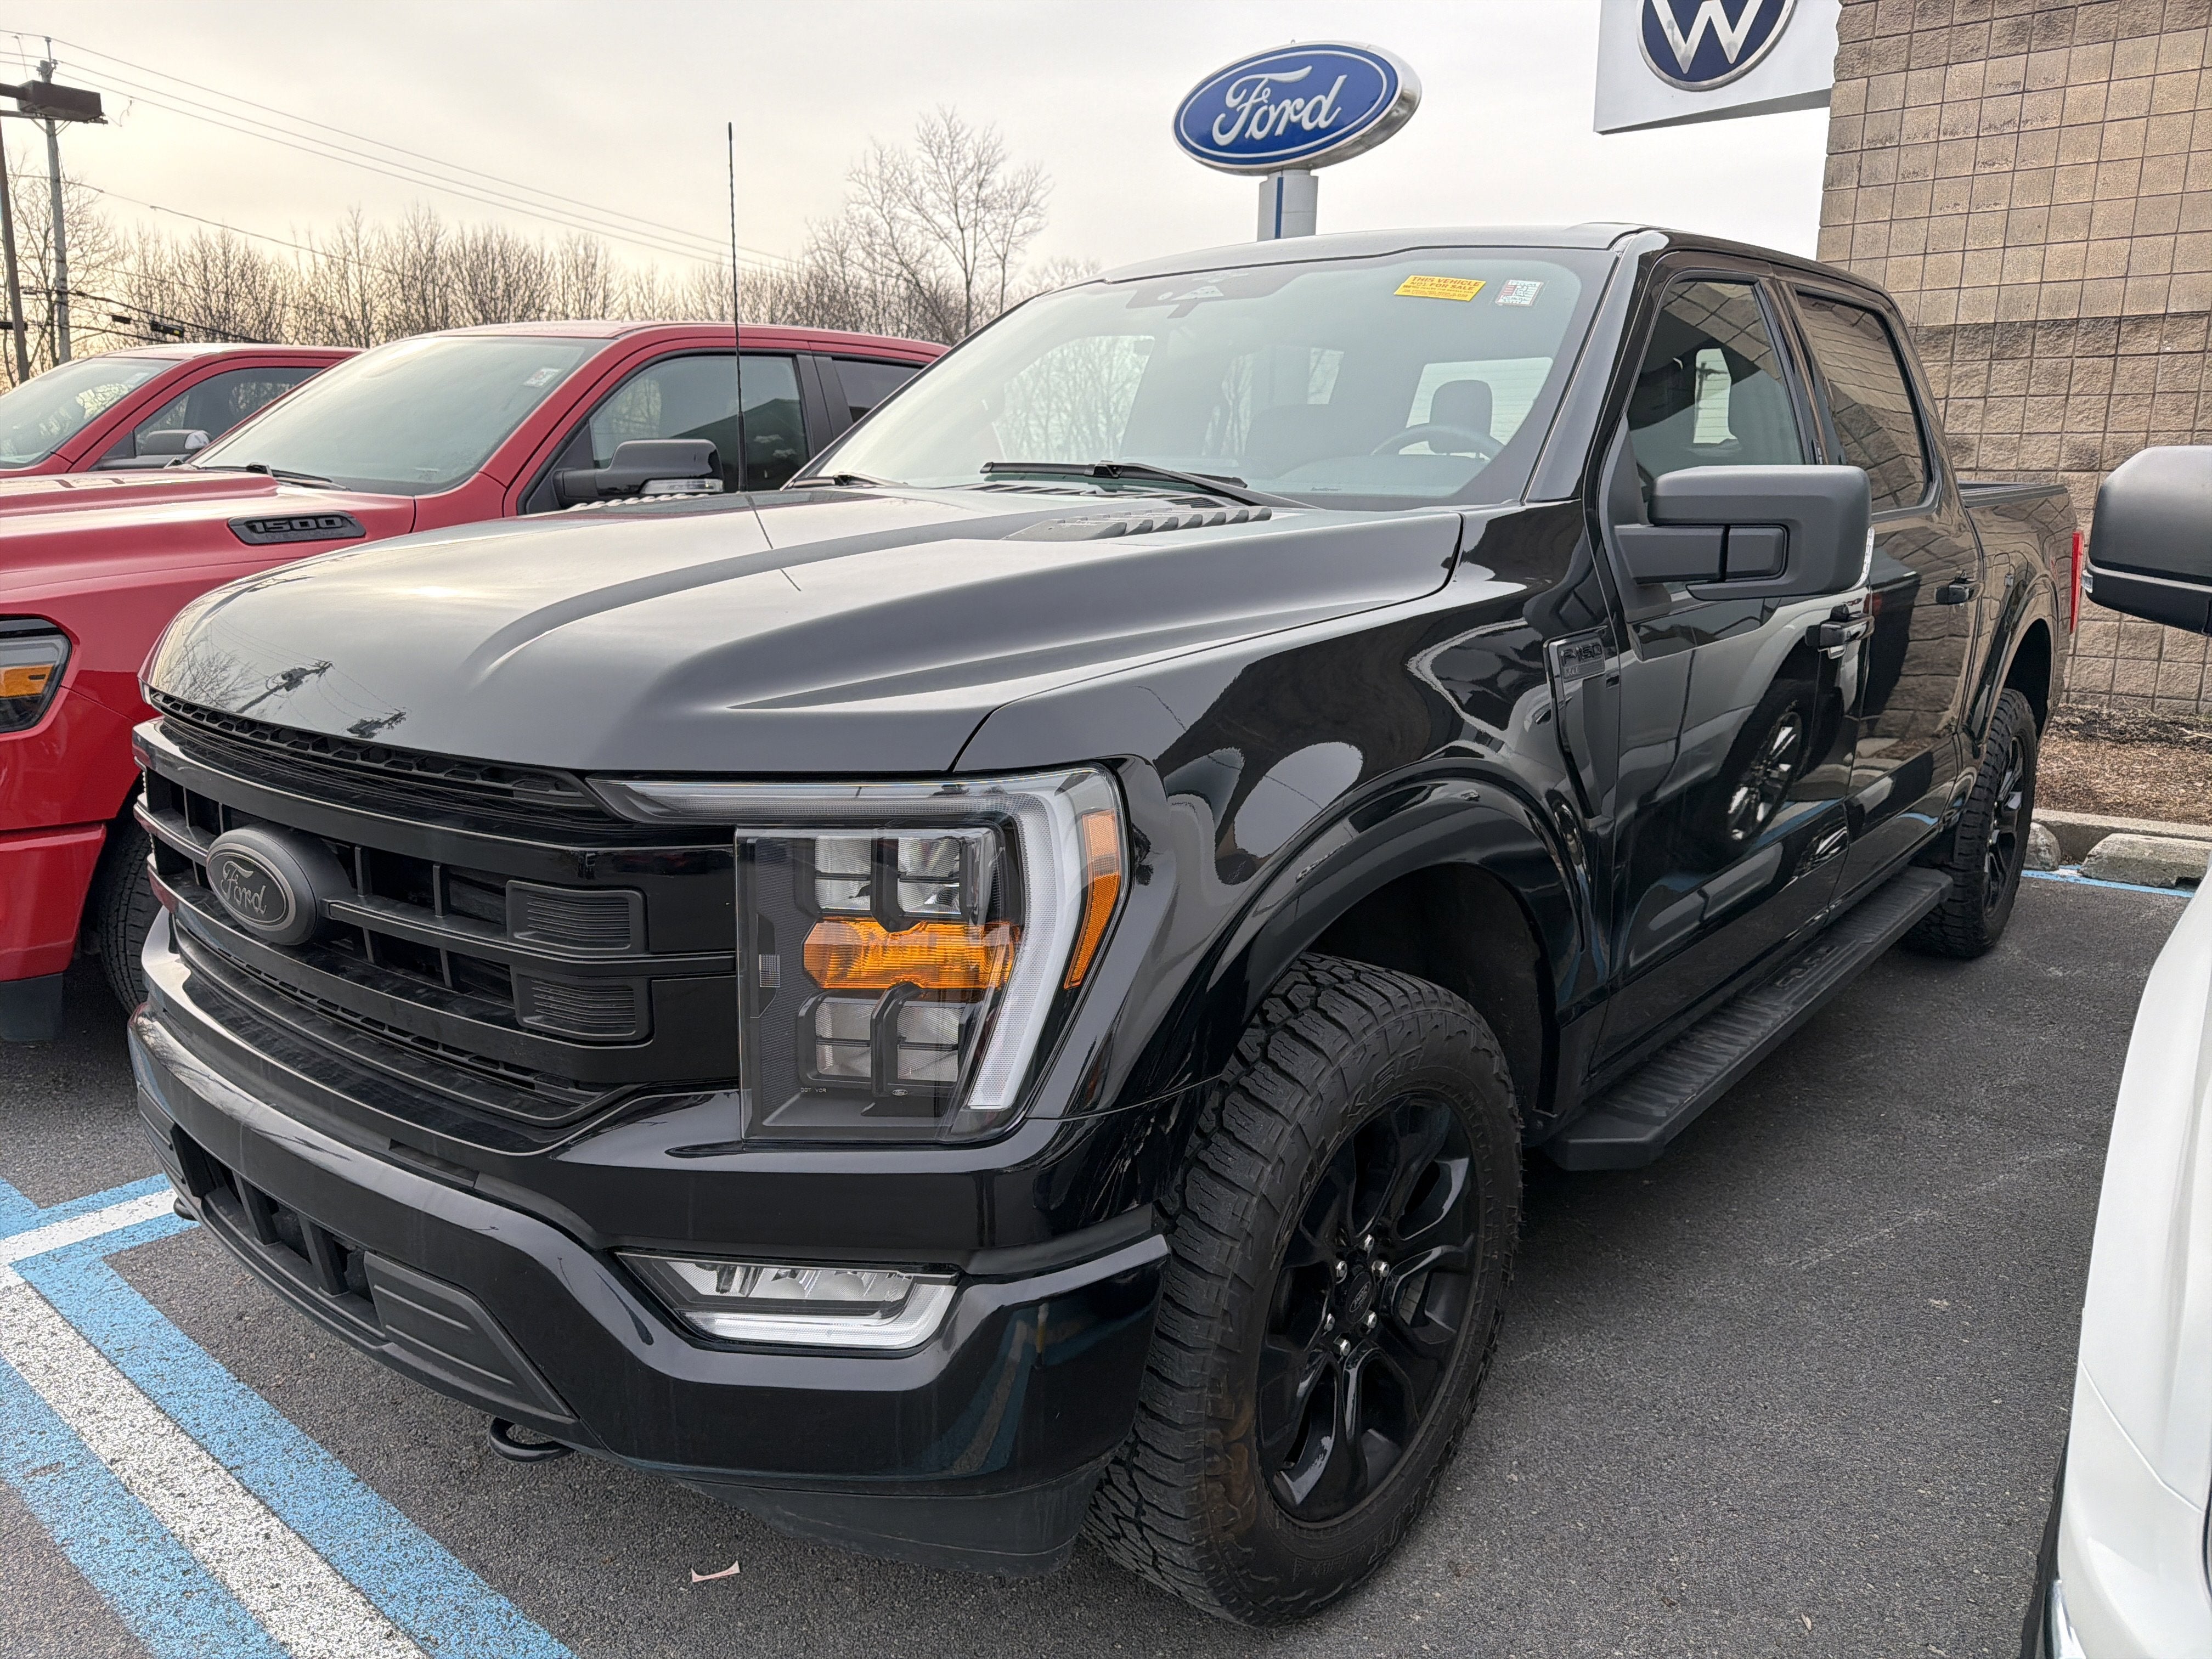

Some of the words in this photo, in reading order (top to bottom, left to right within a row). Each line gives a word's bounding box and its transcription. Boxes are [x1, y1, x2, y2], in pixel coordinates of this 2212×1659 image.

[1212, 65, 1348, 146] Ford
[1437, 278, 1482, 287] VEHICLE
[247, 516, 343, 533] 1500
[220, 860, 267, 915] Ford
